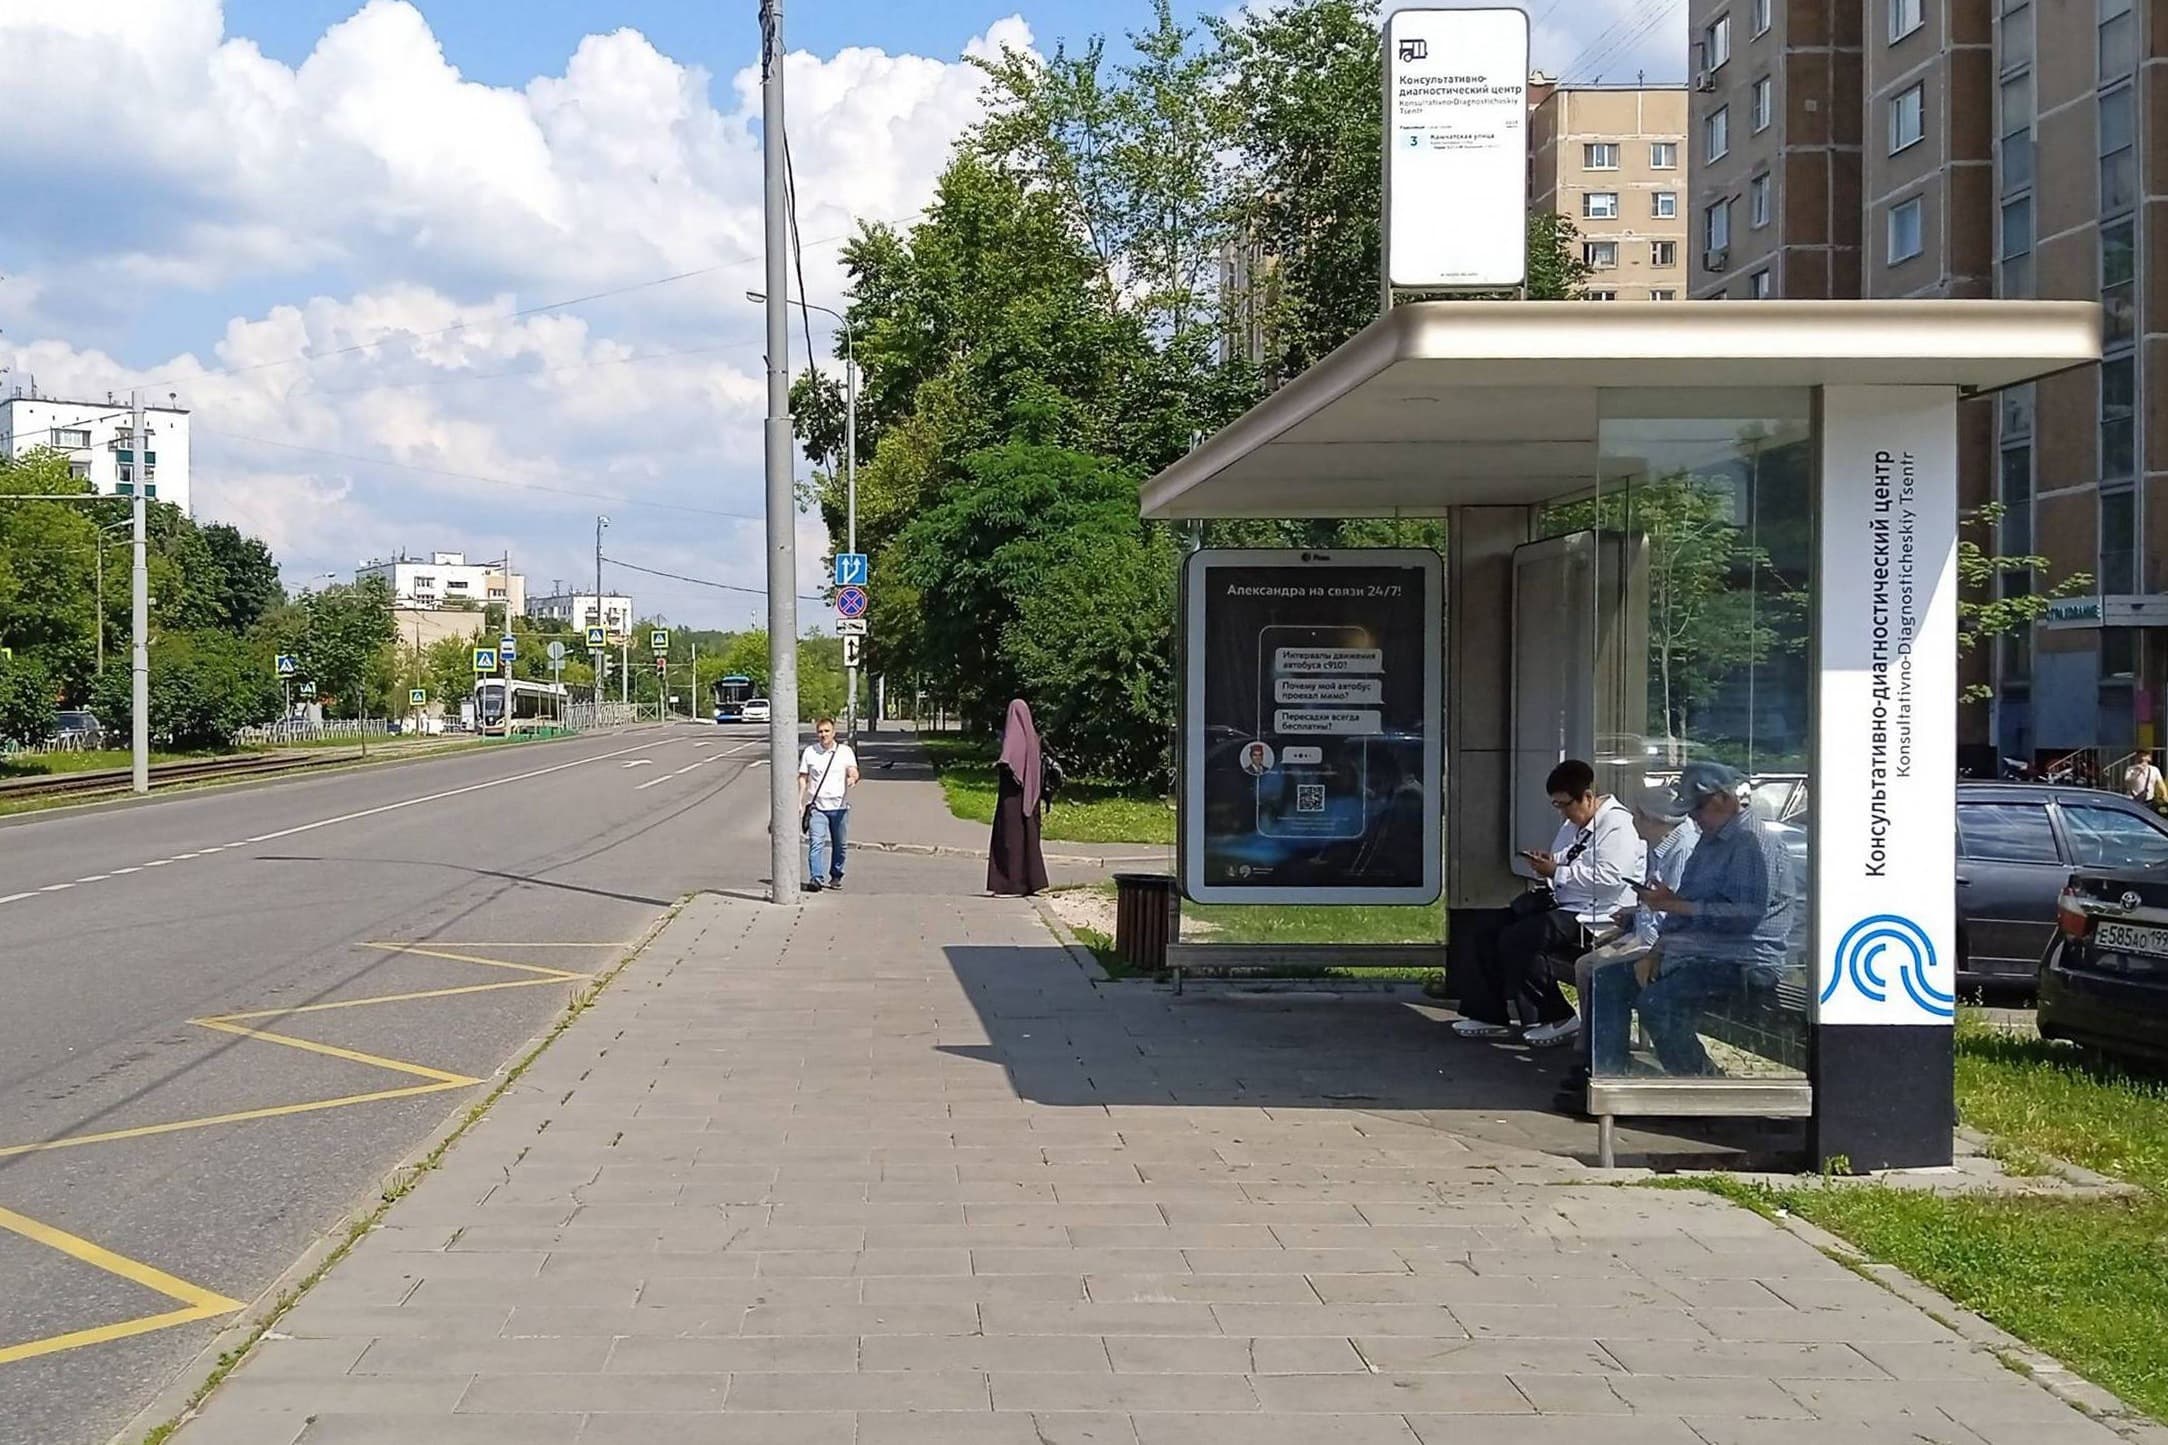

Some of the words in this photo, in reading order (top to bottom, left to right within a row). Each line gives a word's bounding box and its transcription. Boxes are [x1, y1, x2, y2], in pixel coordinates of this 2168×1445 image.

[1399, 75, 1487, 86] Консультативно-
[1399, 85, 1489, 96] диагностический
[1491, 86, 1522, 95] центр
[1410, 136, 1418, 146] 3
[1874, 450, 1895, 513] центр
[1899, 451, 1914, 505] Tsentr
[1226, 584, 1307, 598] Александра
[1309, 586, 1326, 597] на
[1327, 586, 1365, 597] связи
[1367, 585, 1402, 598] 24/7!
[1896, 509, 1917, 778] Konsultativno-Diagnosticheskiy
[1282, 651, 1332, 660] Интервалы
[1333, 652, 1376, 661] движения
[1282, 661, 1322, 671] автобуса
[1282, 682, 1316, 691] Почему
[1317, 682, 1336, 690] мой
[1337, 683, 1371, 692] автобус
[1320, 692, 1349, 700] мимо?
[1865, 520, 1891, 877] Консультативно-диагностический
[1281, 712, 1330, 722] Пересадки
[1331, 714, 1360, 722] всегда
[1281, 722, 1332, 731] бесплатны?
